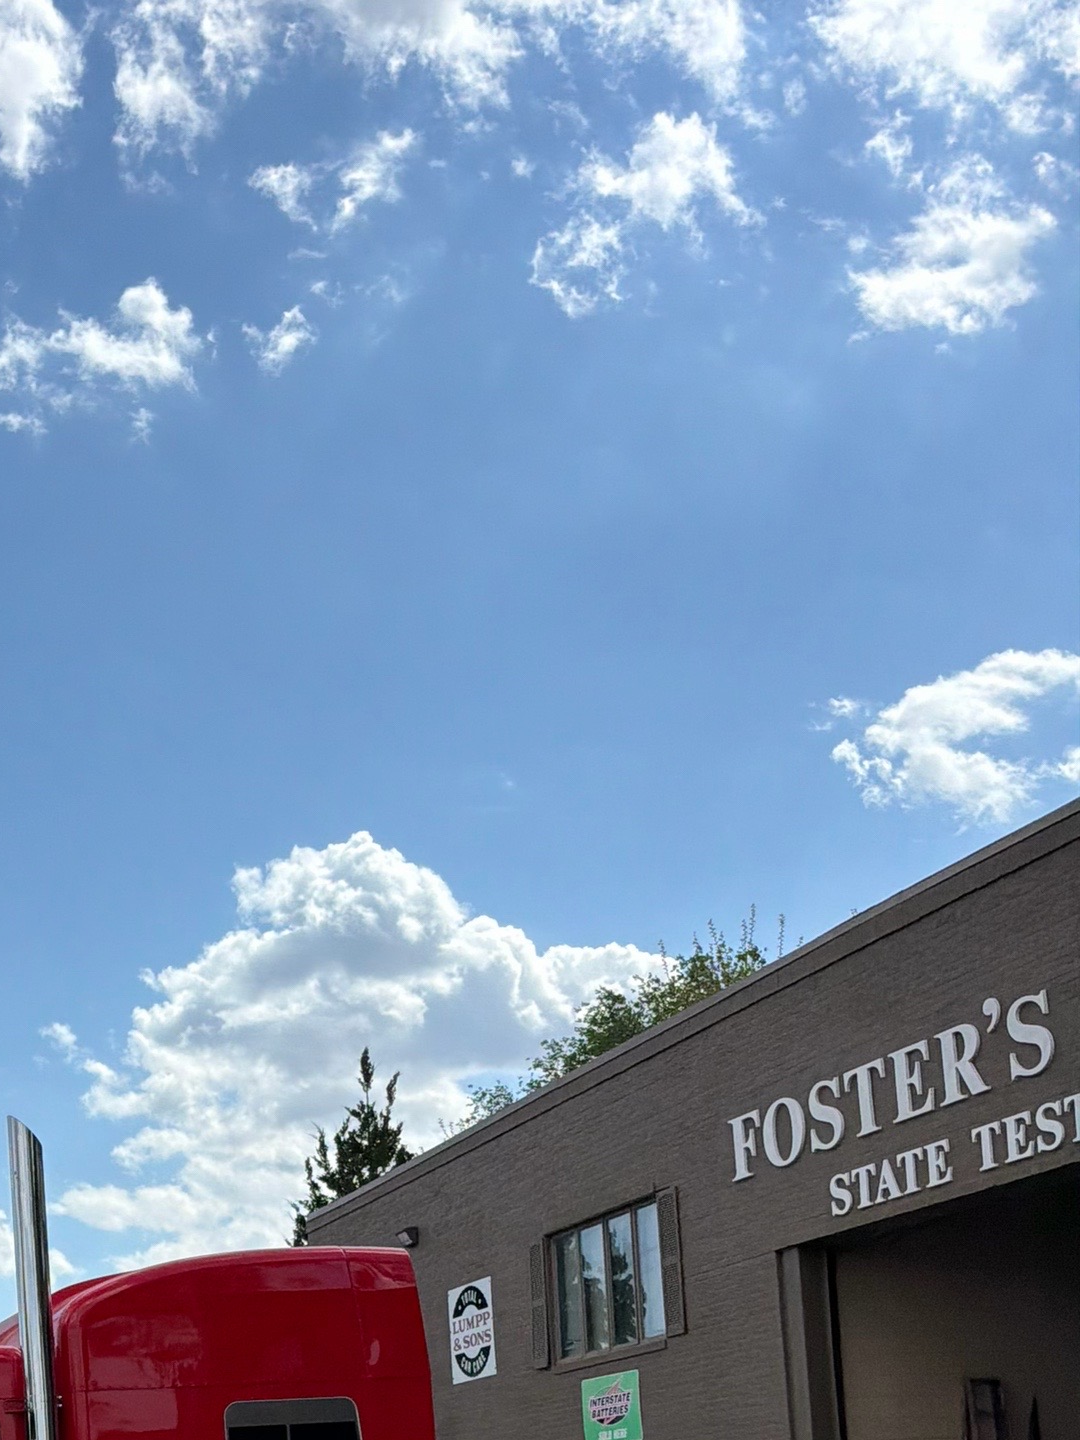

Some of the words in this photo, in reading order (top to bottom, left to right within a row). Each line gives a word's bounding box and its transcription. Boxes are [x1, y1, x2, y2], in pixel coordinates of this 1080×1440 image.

[727, 989, 1055, 1182] FOSTER'S
[829, 1138, 954, 1216] STATE
[461, 1290, 477, 1306] TOTAL
[452, 1311, 491, 1335] LUMPP
[453, 1338, 462, 1352] &
[463, 1328, 492, 1349] SONS
[590, 1391, 631, 1407] INTERSTATE
[592, 1404, 629, 1419] BATTERIES
